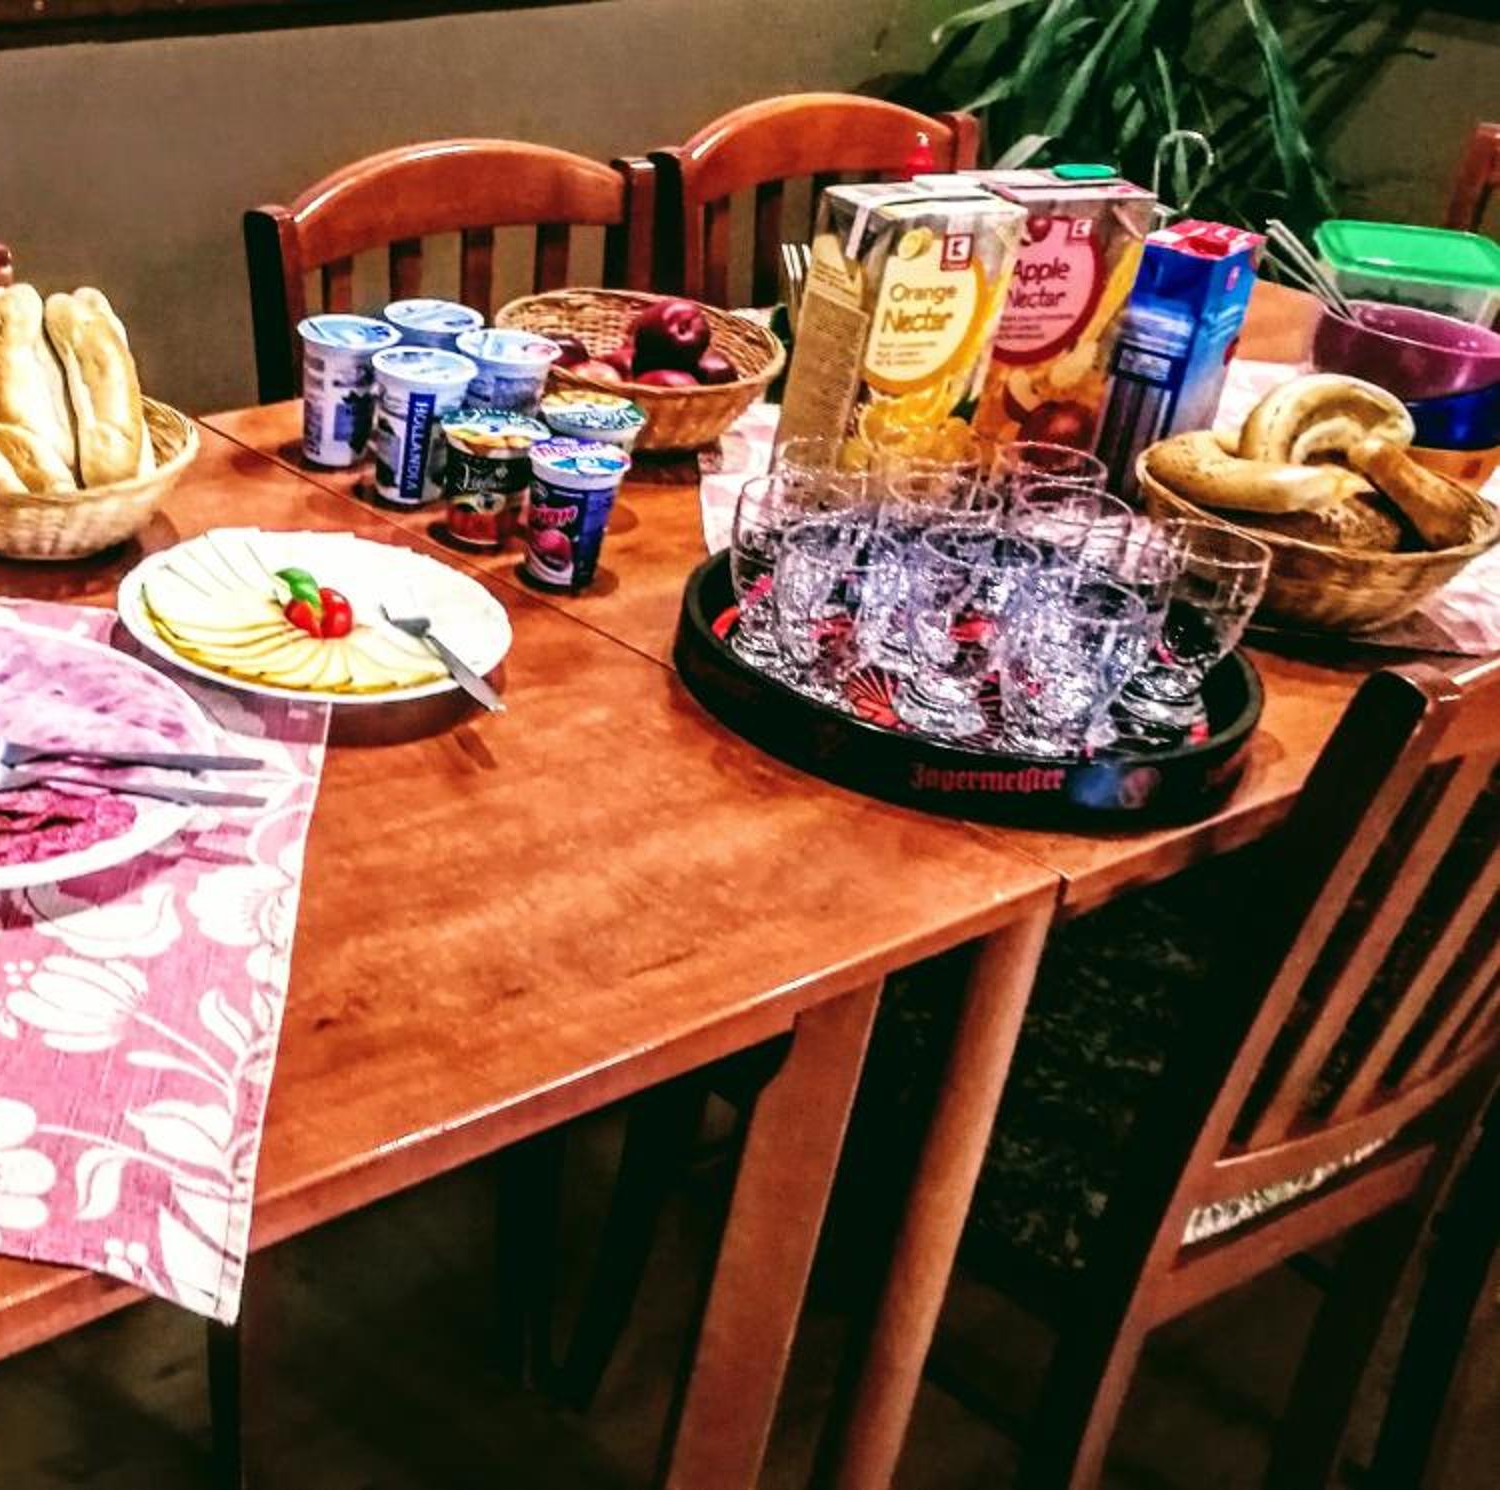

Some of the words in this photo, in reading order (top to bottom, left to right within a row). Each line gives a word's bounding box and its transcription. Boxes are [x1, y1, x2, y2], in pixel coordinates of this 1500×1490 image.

[1012, 256, 1071, 286] Apple
[890, 282, 958, 305] Orange
[880, 306, 954, 335] Nectar
[406, 401, 431, 492] HOLLANDIA
